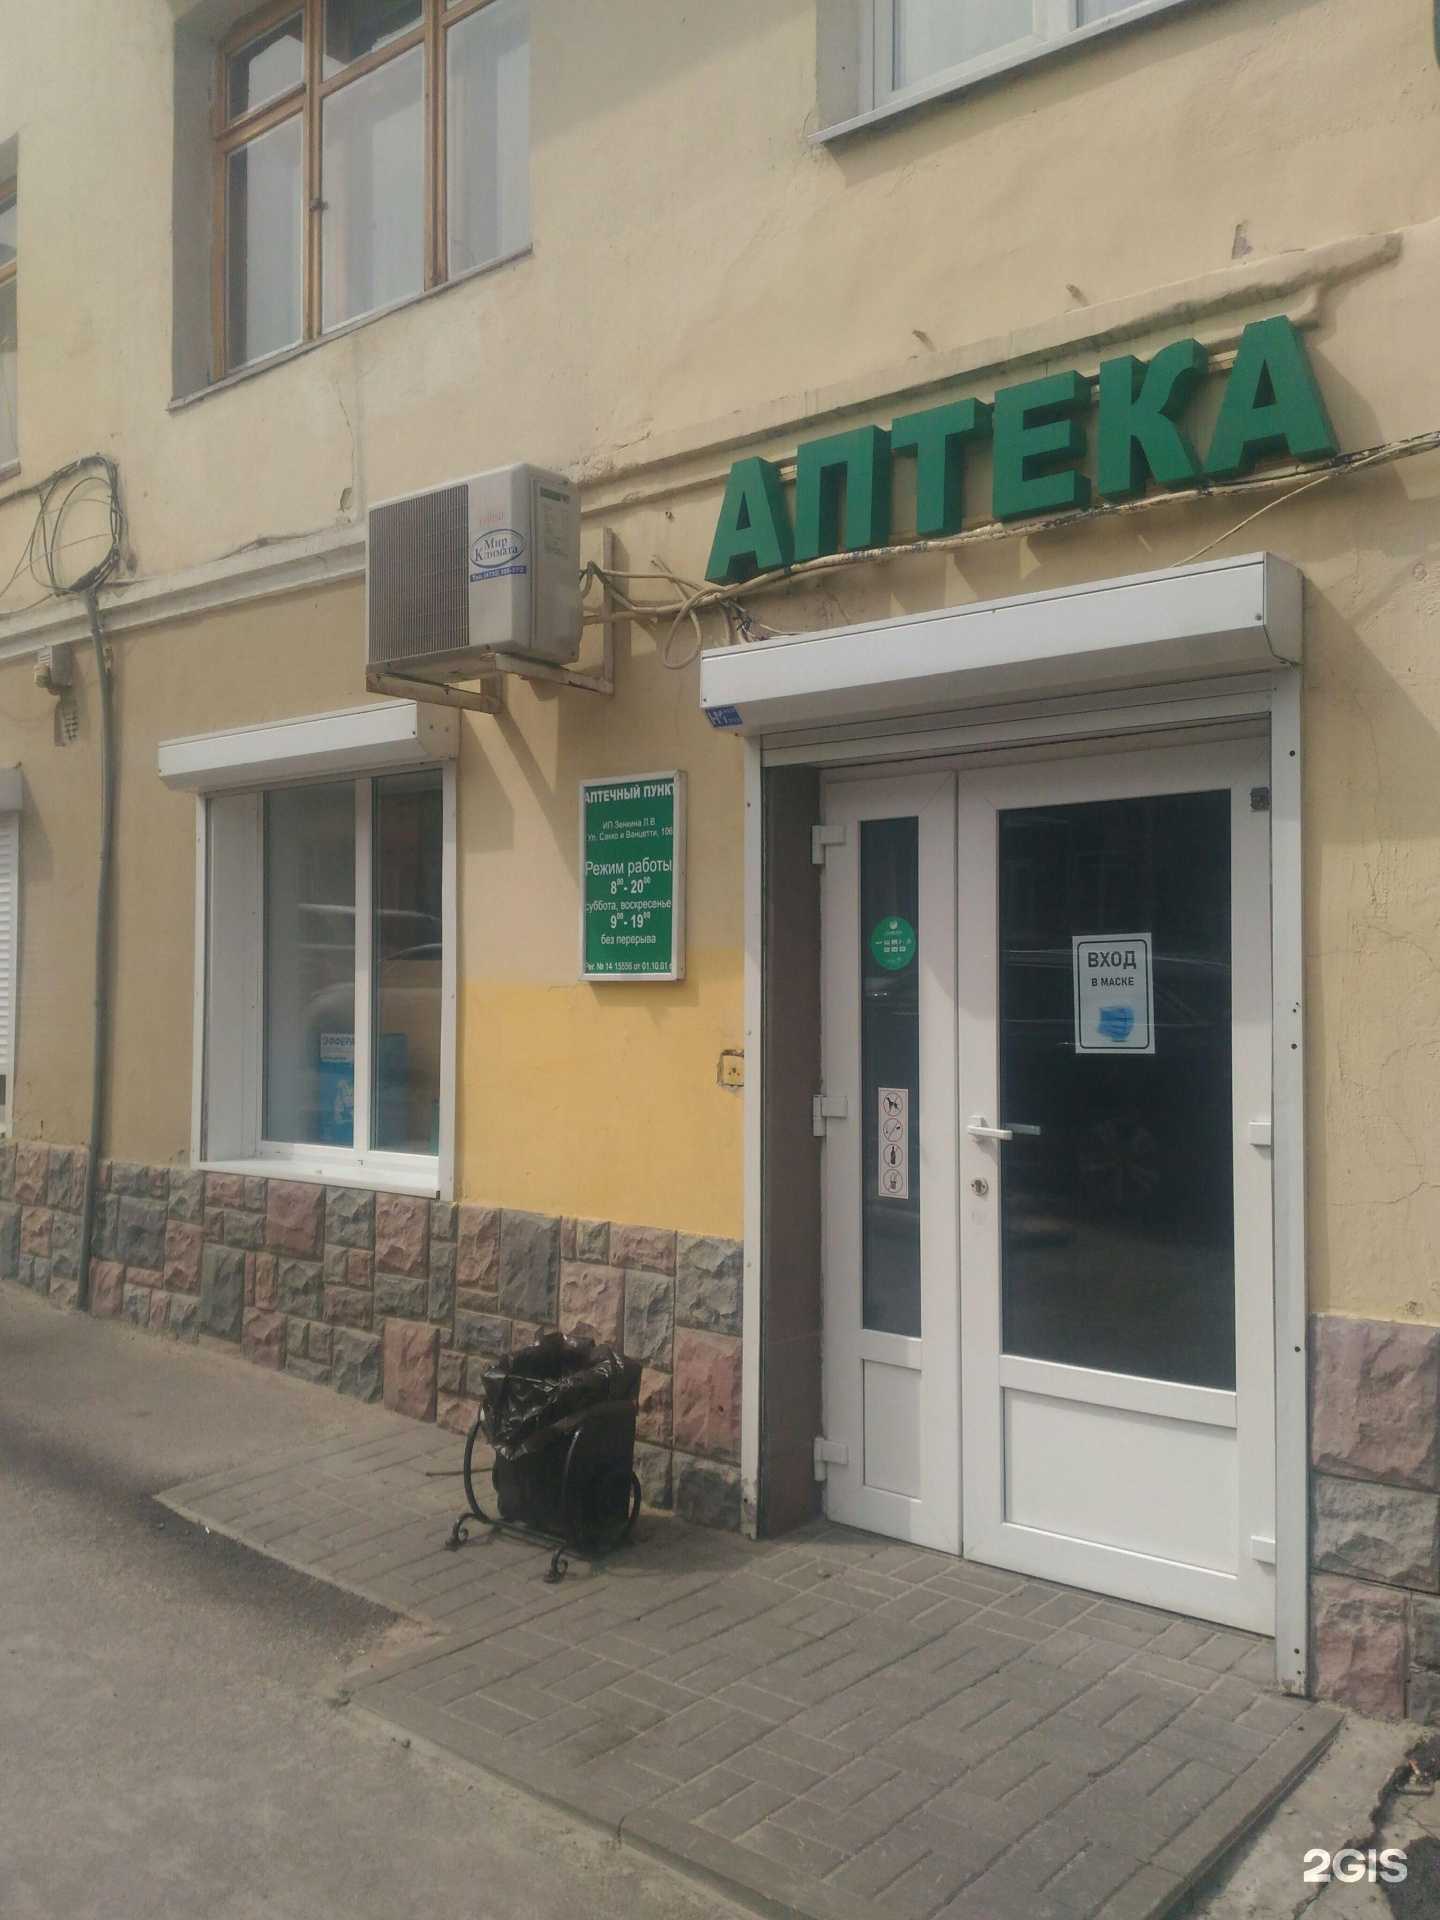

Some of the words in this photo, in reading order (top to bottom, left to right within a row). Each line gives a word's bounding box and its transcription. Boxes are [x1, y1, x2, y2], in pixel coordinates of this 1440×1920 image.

[704, 314, 1336, 585] АПТЕКА
[484, 537, 508, 551] Мир
[475, 546, 518, 562] Климата
[585, 784, 641, 804] АПТЕЧНЫЙ
[602, 820, 613, 830] ИП
[585, 861, 625, 877] Режим
[628, 857, 672, 877] работы
[600, 933, 615, 945] без
[616, 935, 657, 947] перерыва
[1088, 950, 1137, 970] ВХОД
[1091, 977, 1098, 987] В
[1100, 976, 1135, 987] МАСКЕ
